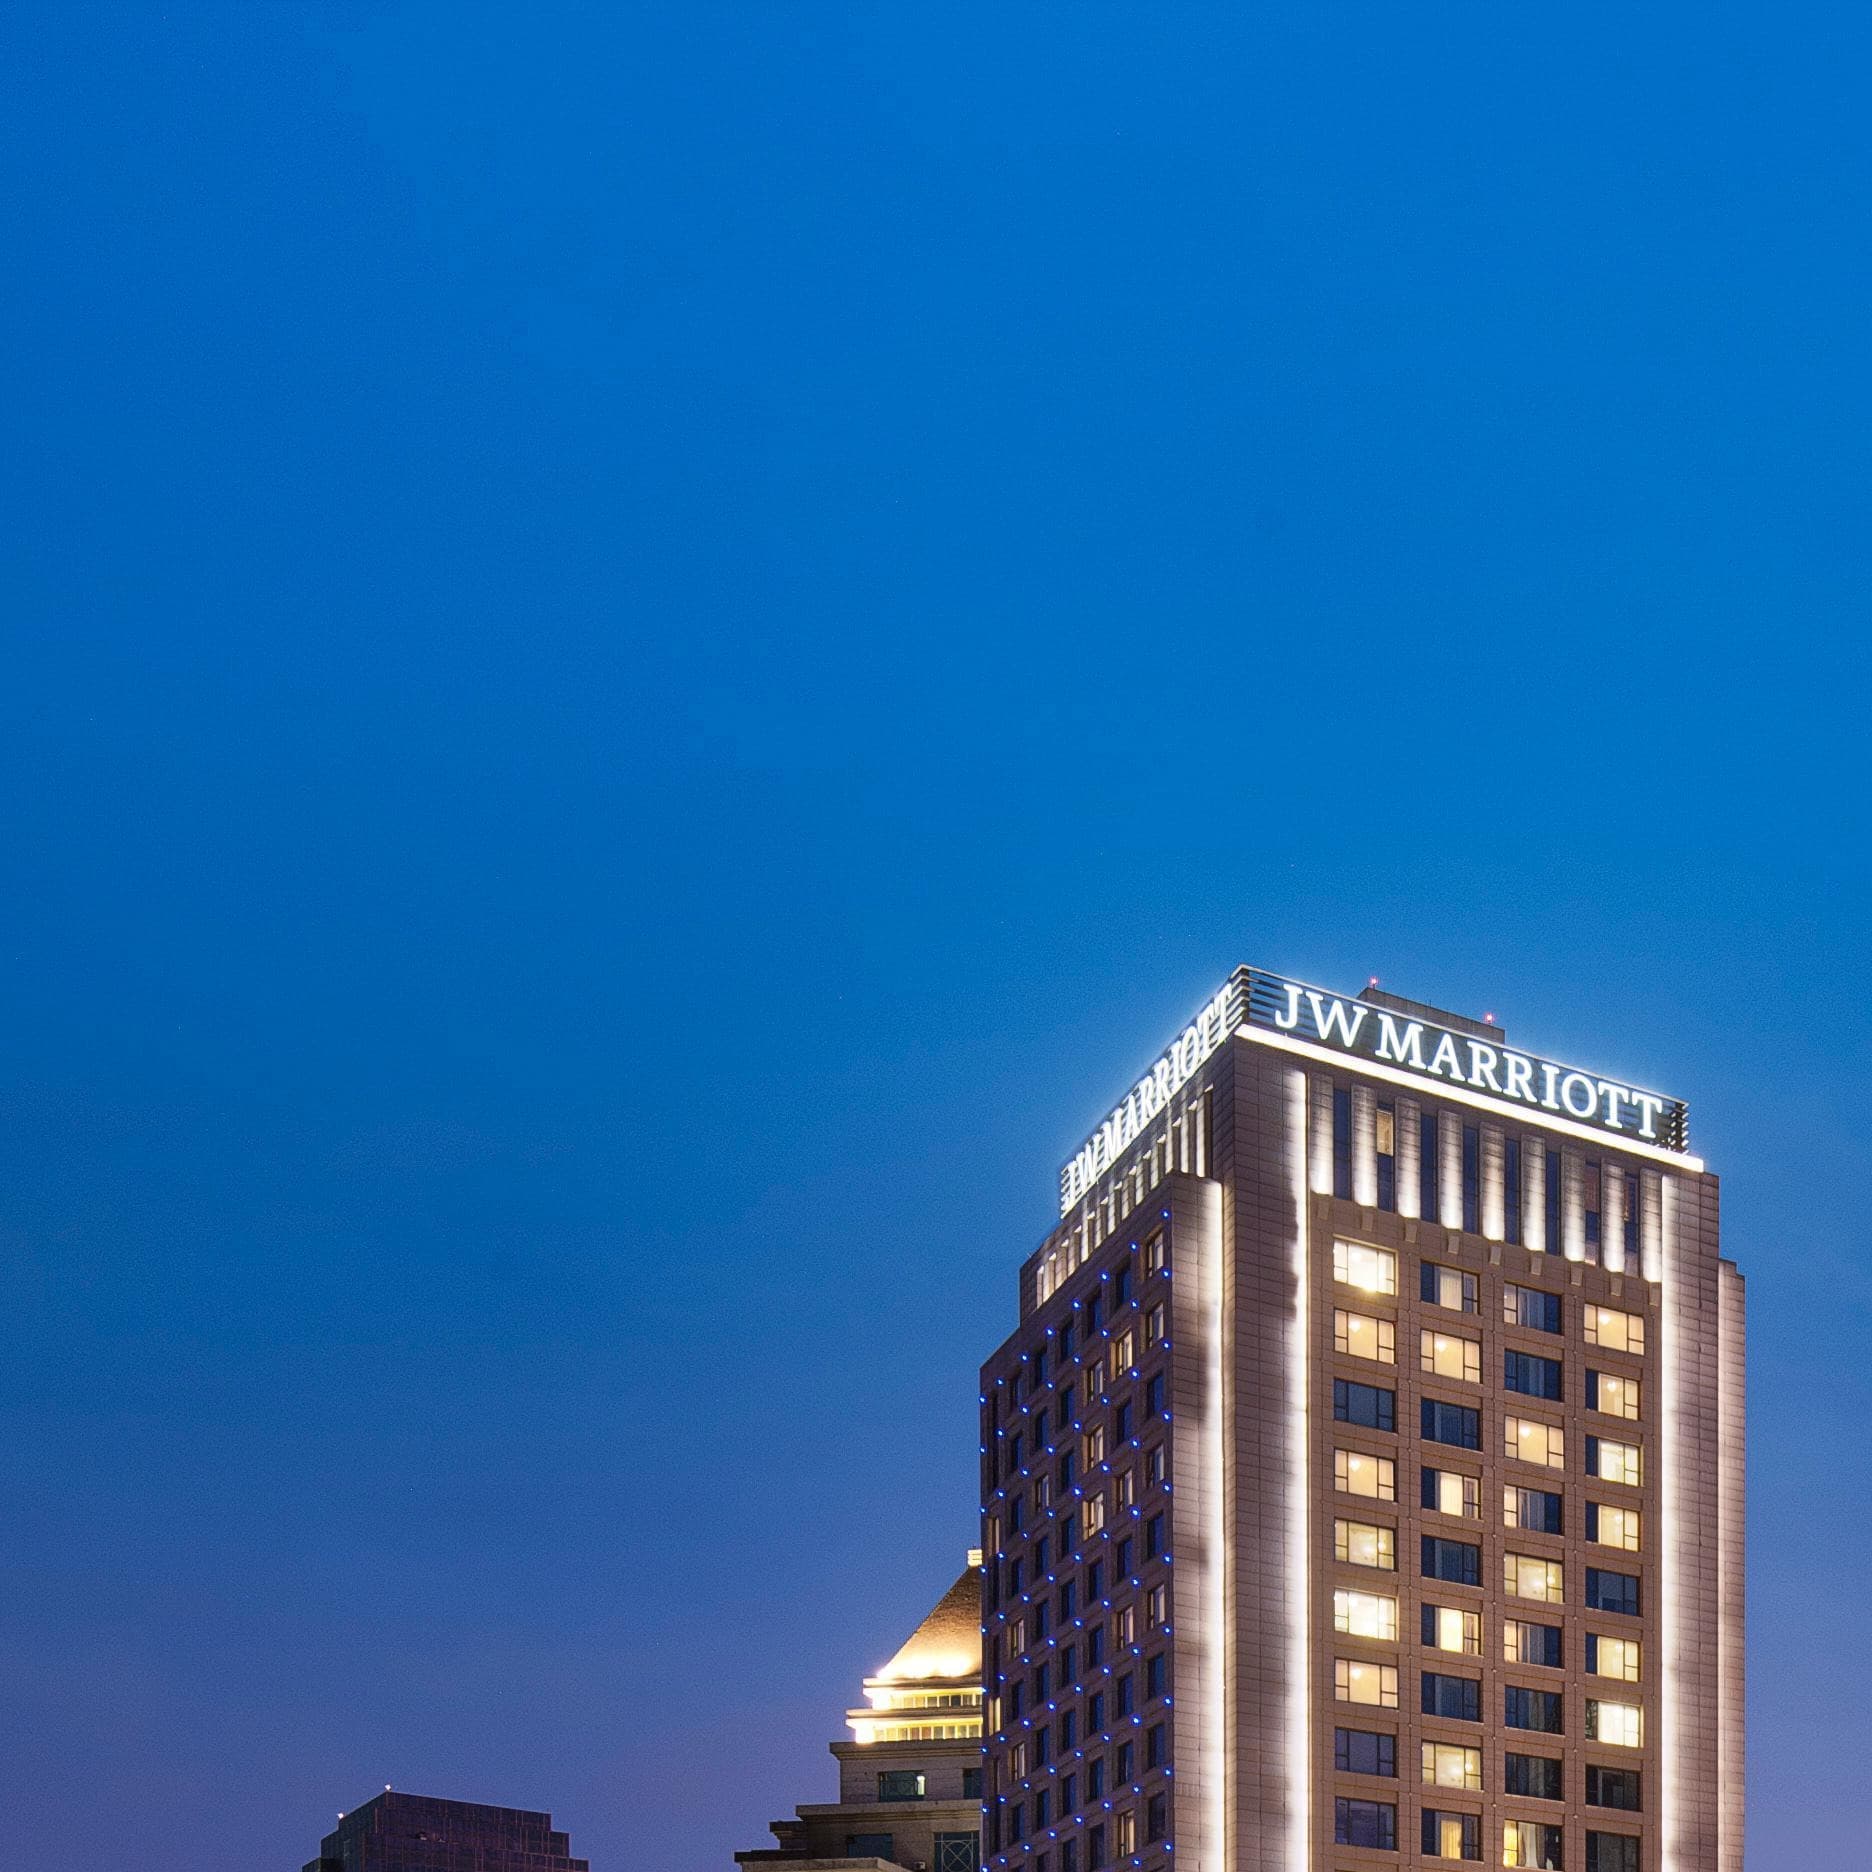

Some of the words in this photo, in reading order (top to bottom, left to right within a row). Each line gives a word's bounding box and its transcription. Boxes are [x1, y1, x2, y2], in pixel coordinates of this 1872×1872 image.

[1061, 1133, 1102, 1210] JW
[1097, 982, 1233, 1172] MARRIOTT
[1275, 983, 1368, 1048] JW
[1375, 1013, 1662, 1138] MARRIOTT
